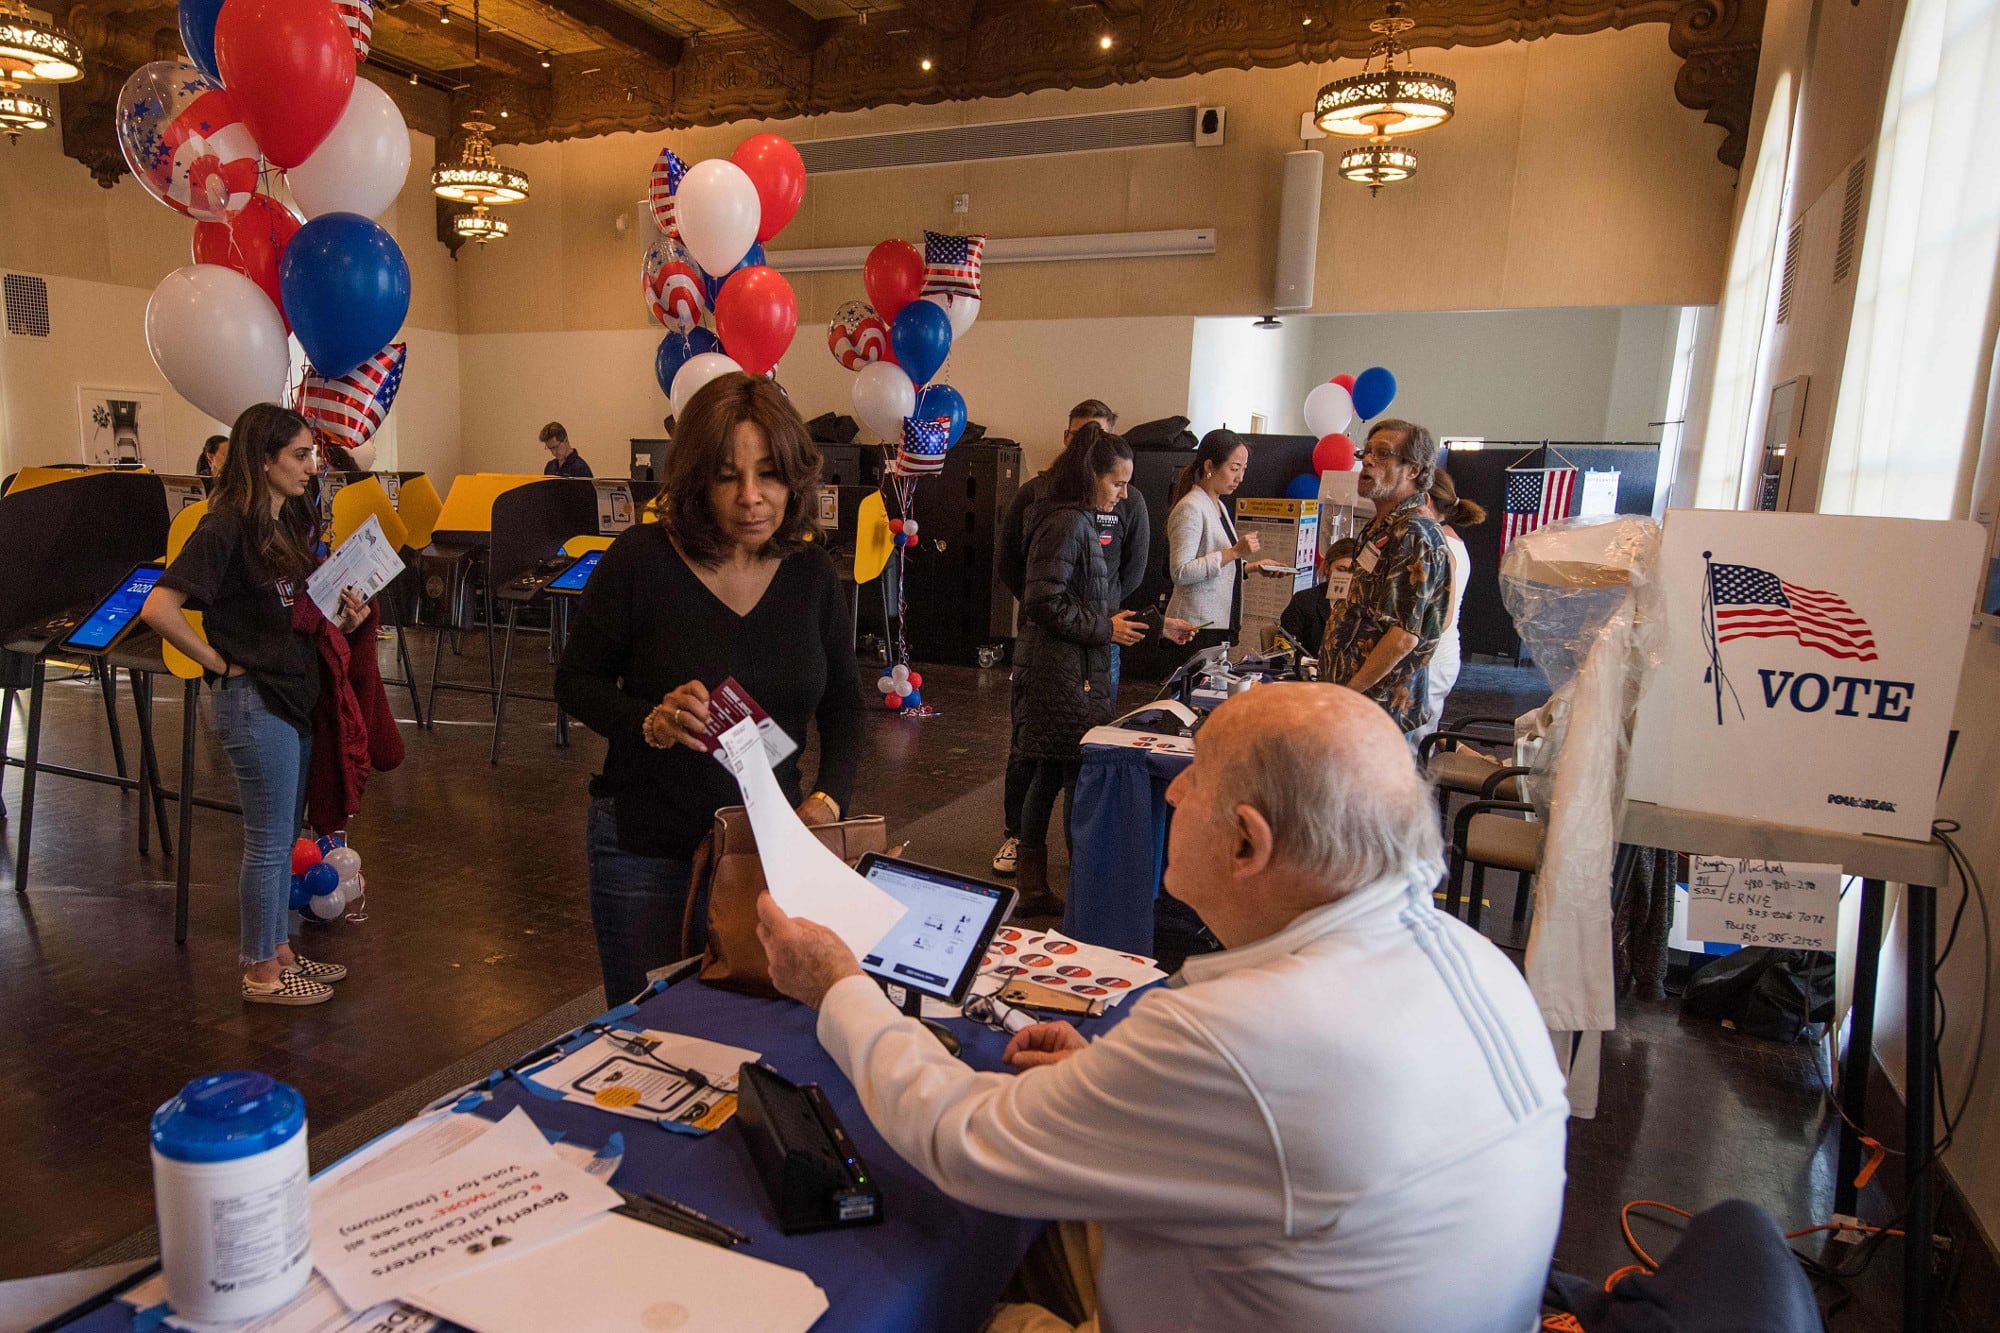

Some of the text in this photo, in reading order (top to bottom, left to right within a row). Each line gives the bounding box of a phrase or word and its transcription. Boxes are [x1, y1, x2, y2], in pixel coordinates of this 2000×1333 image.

[126, 583, 153, 593] 2020
[1758, 669, 1915, 722] VOTE
[1728, 892, 1772, 908] ERNIE
[338, 1164, 521, 1237] Vote for 2 (maximum)
[344, 1170, 540, 1253] Press "MORE" to see all
[469, 1189, 529, 1220] Council
[369, 1217, 467, 1259] Candidates
[370, 1191, 569, 1277] Beverly Hills Voters
